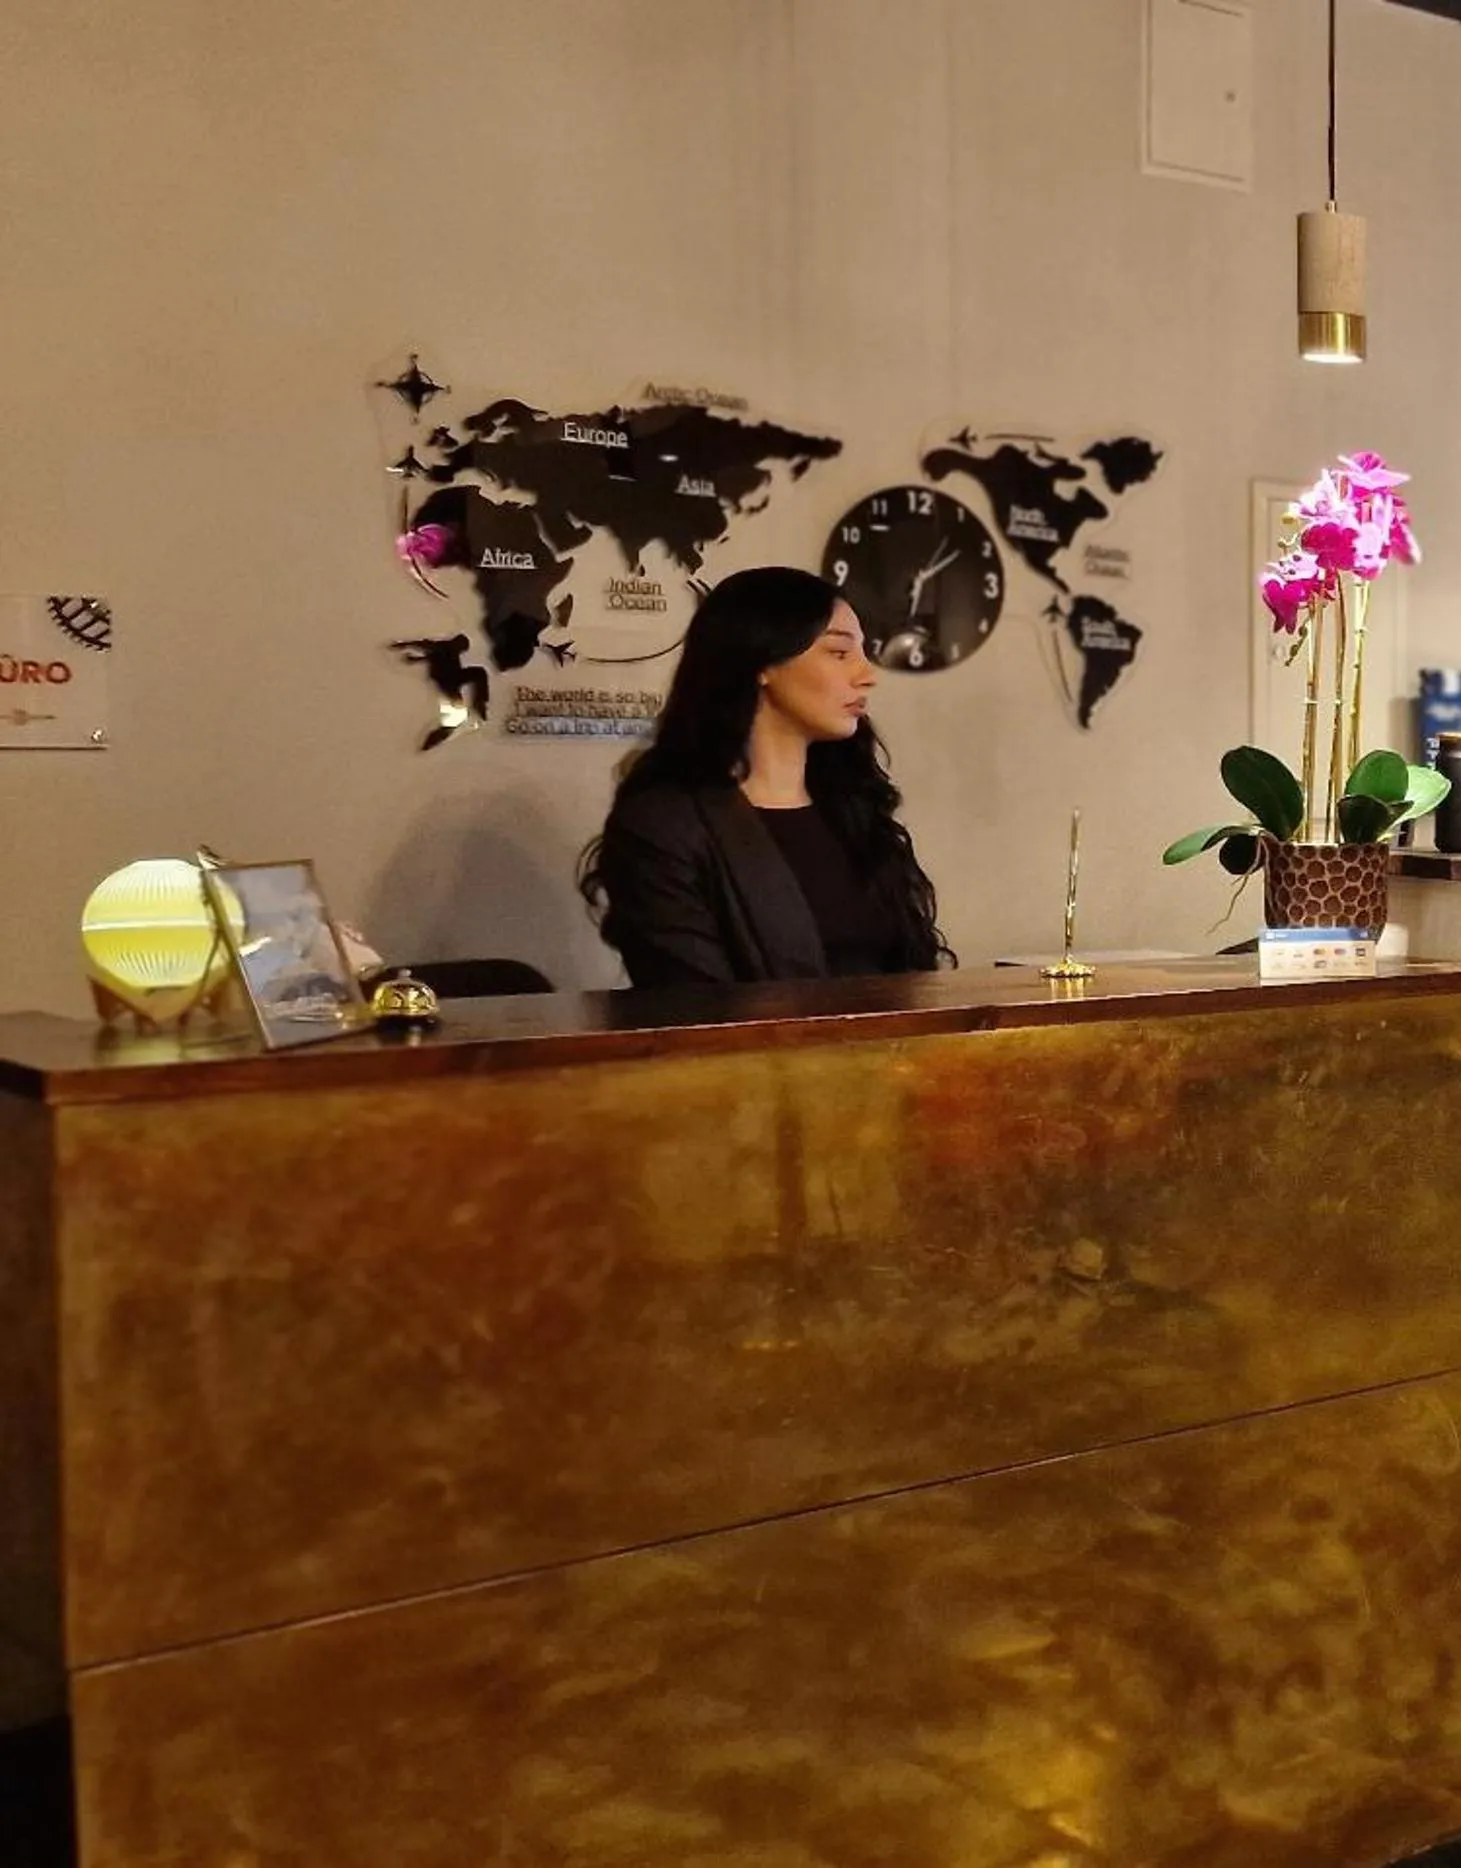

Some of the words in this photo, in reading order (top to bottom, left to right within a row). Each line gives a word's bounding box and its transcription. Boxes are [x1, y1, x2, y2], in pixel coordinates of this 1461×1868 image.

[563, 421, 629, 448] Europe
[677, 473, 717, 497] Asia
[907, 490, 933, 515] 12
[842, 526, 861, 544] 10
[480, 547, 536, 569] Africa
[833, 560, 849, 587] 9
[608, 577, 662, 595] Indian
[983, 572, 999, 599] 3
[608, 593, 667, 611] Ocean
[908, 640, 925, 668] 6
[551, 688, 595, 702] world
[615, 691, 634, 704] so
[506, 716, 528, 734] Go
